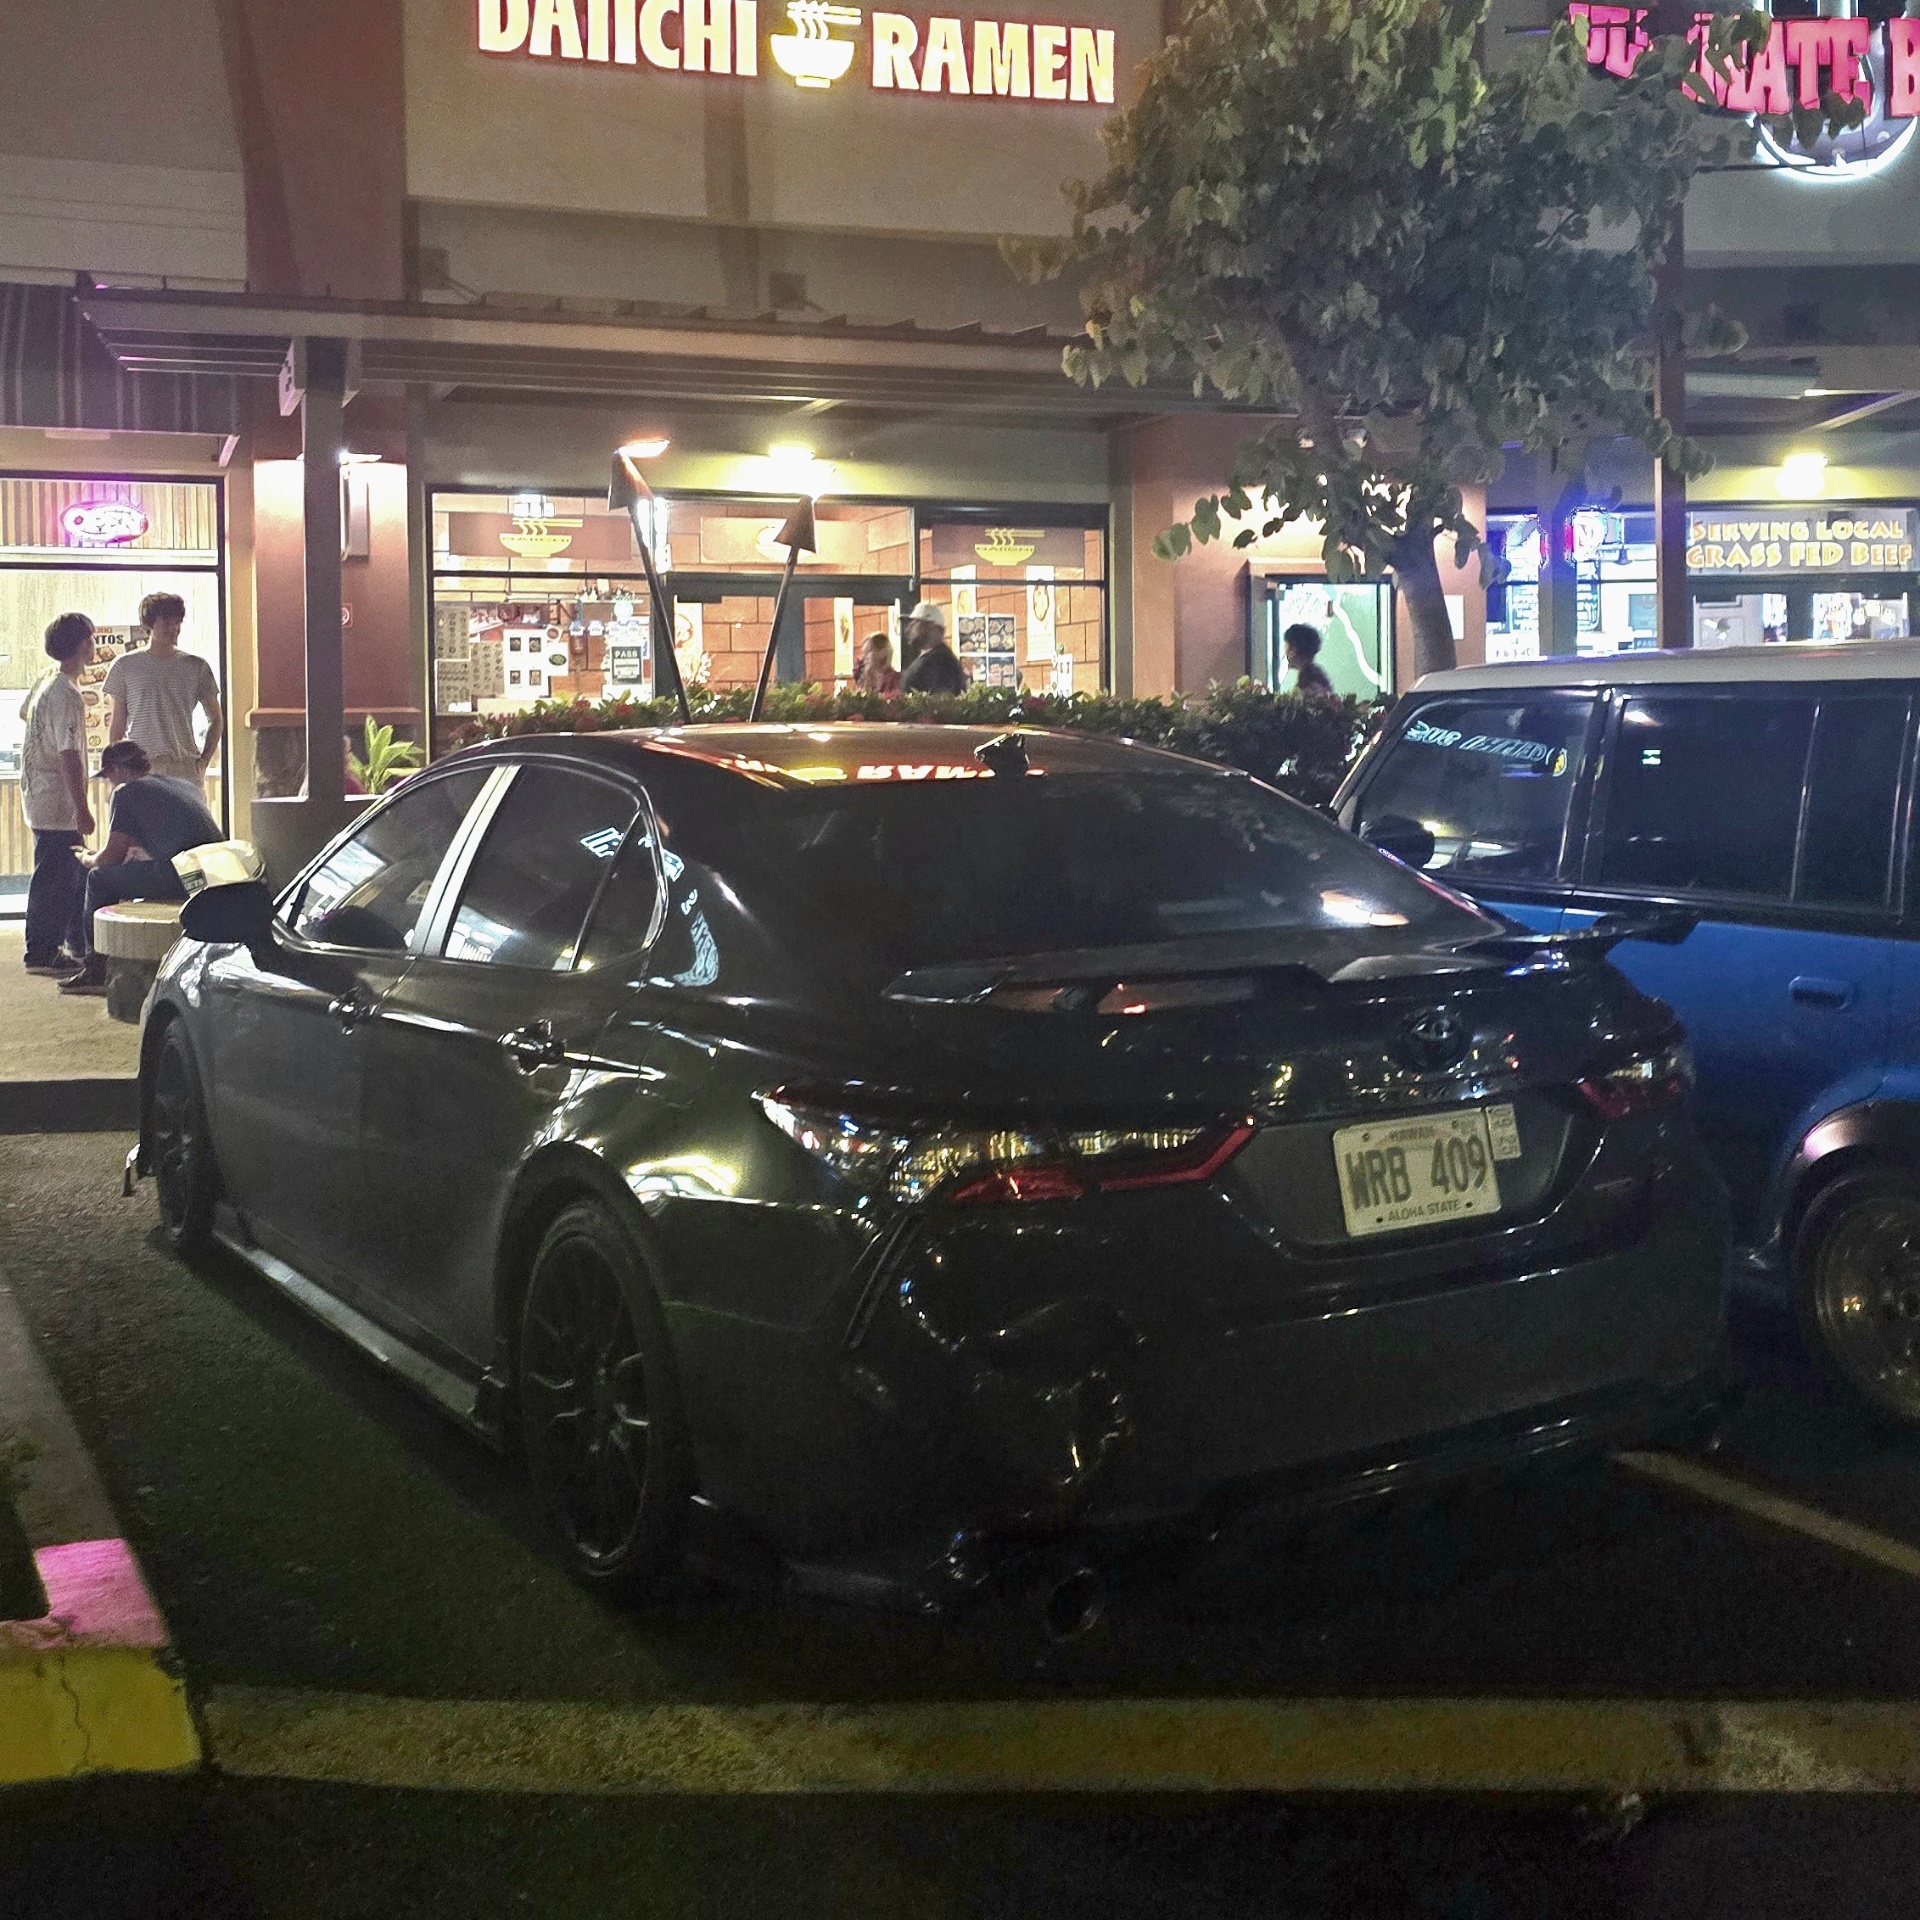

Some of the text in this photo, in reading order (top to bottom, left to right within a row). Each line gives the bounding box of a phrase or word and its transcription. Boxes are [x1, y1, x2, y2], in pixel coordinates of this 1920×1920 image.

[478, 0, 1115, 104] DAIICHI RAMEN
[1692, 519, 1904, 543] SERVING LOCAL
[1685, 541, 1913, 568] GRASS FED BEEF
[1430, 1134, 1487, 1195] 409
[1388, 1199, 1461, 1220] ALOHA STATE
